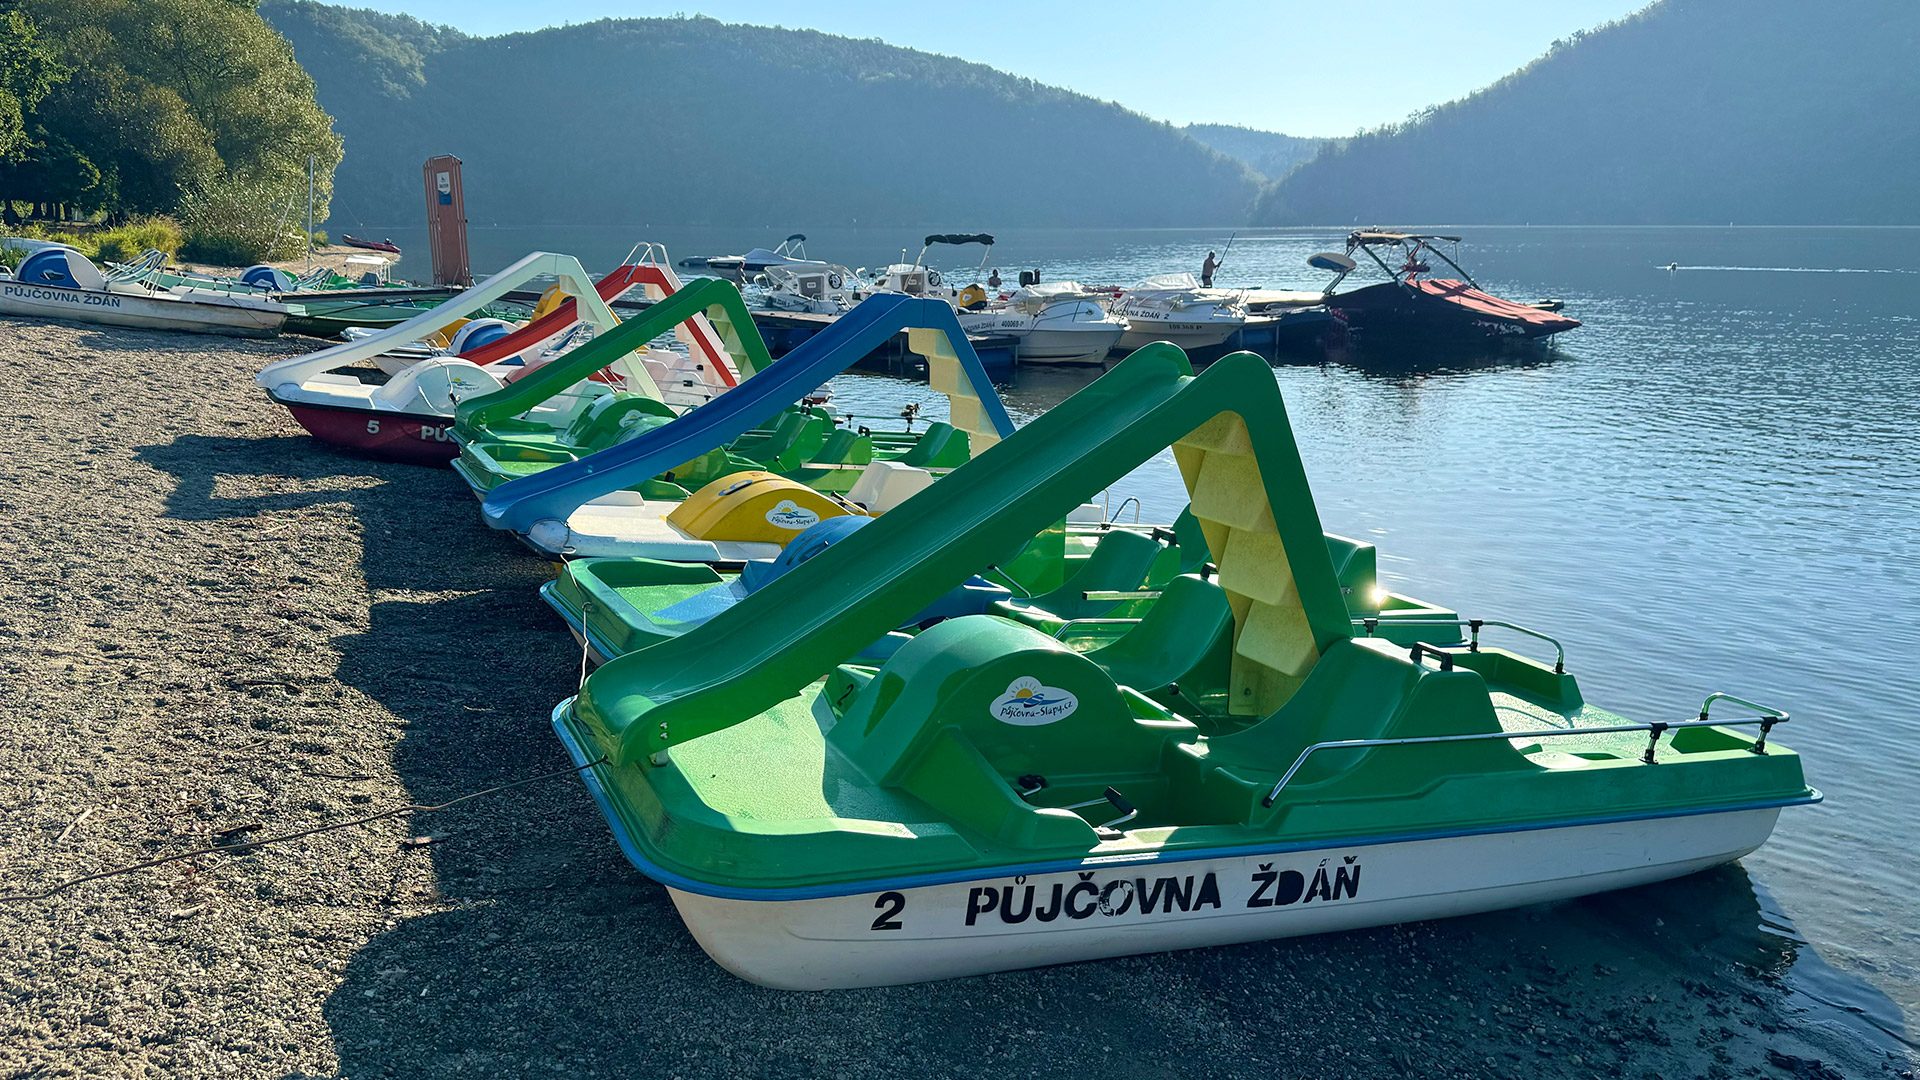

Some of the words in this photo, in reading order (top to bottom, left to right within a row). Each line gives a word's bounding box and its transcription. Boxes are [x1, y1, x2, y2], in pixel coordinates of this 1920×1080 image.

[4, 285, 79, 303] PŮJČOVNA
[83, 293, 120, 307] ŽDÁŇ
[366, 420, 380, 434] 5
[837, 684, 854, 707] 2
[965, 872, 1222, 926] PŮJČOVNA
[1247, 856, 1361, 908] ŽDÁŇ
[871, 892, 906, 930] 2
